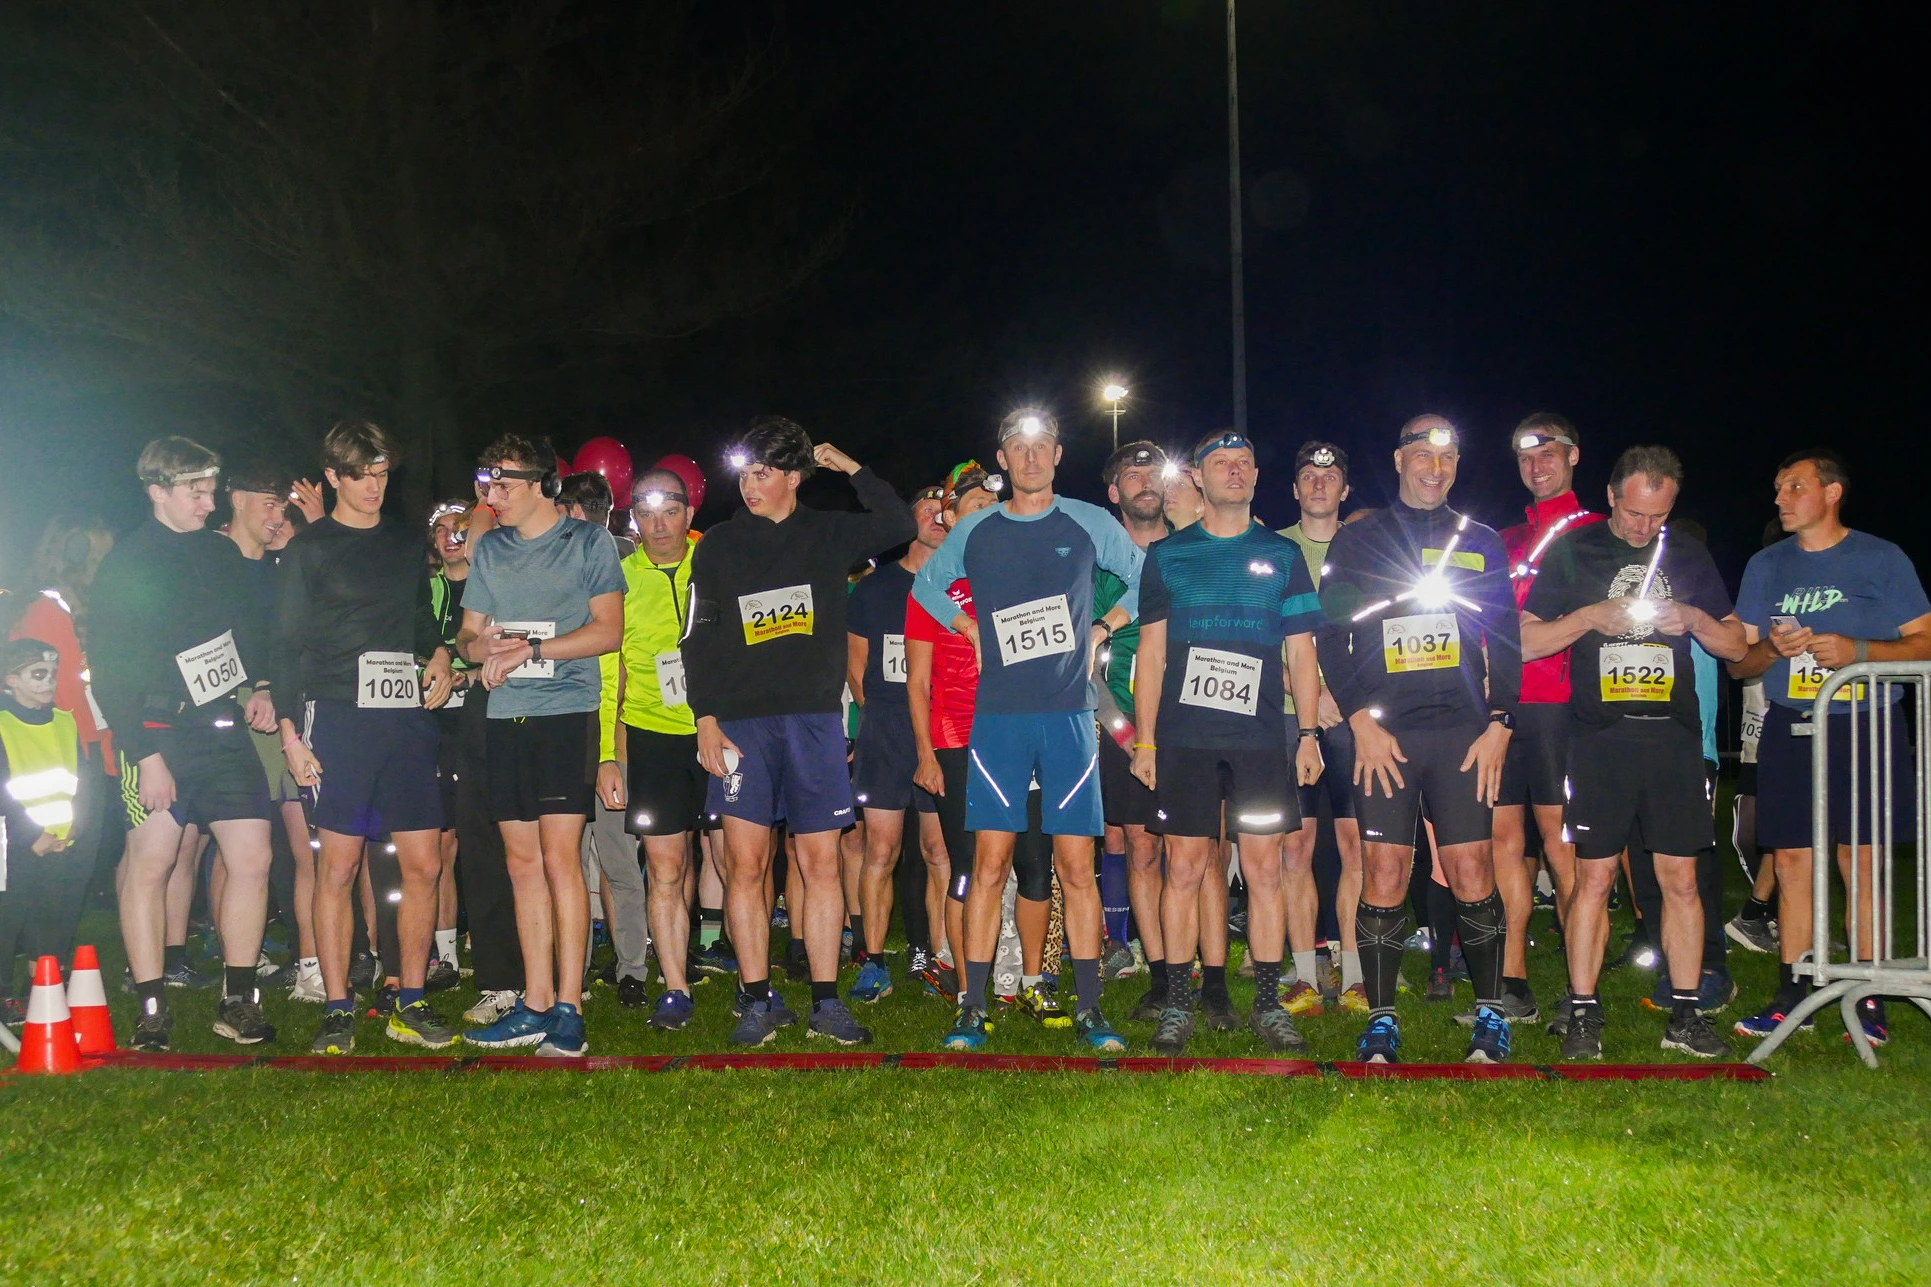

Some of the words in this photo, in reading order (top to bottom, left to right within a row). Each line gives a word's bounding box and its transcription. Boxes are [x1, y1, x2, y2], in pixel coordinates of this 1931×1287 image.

[1781, 589, 1843, 614] WILD
[752, 602, 809, 629] 2124
[1001, 611, 1031, 624] Marathon
[1031, 607, 1045, 615] and
[1045, 604, 1061, 612] More
[1019, 616, 1046, 626] Belgium
[754, 625, 782, 637] Marathon
[1005, 623, 1067, 654] 1515
[1392, 633, 1451, 656] 1037
[185, 649, 213, 664] Marathon
[214, 645, 223, 653] and
[204, 653, 225, 665] Belgium
[1194, 655, 1225, 664] Marathon
[1226, 660, 1240, 668] and
[1240, 662, 1256, 671] More
[1395, 656, 1425, 665] Marathon
[193, 657, 238, 693] 1050
[1210, 665, 1238, 675] Belgium
[1607, 666, 1666, 685] 1522
[365, 678, 414, 699] 1020
[1190, 675, 1251, 705] 1084
